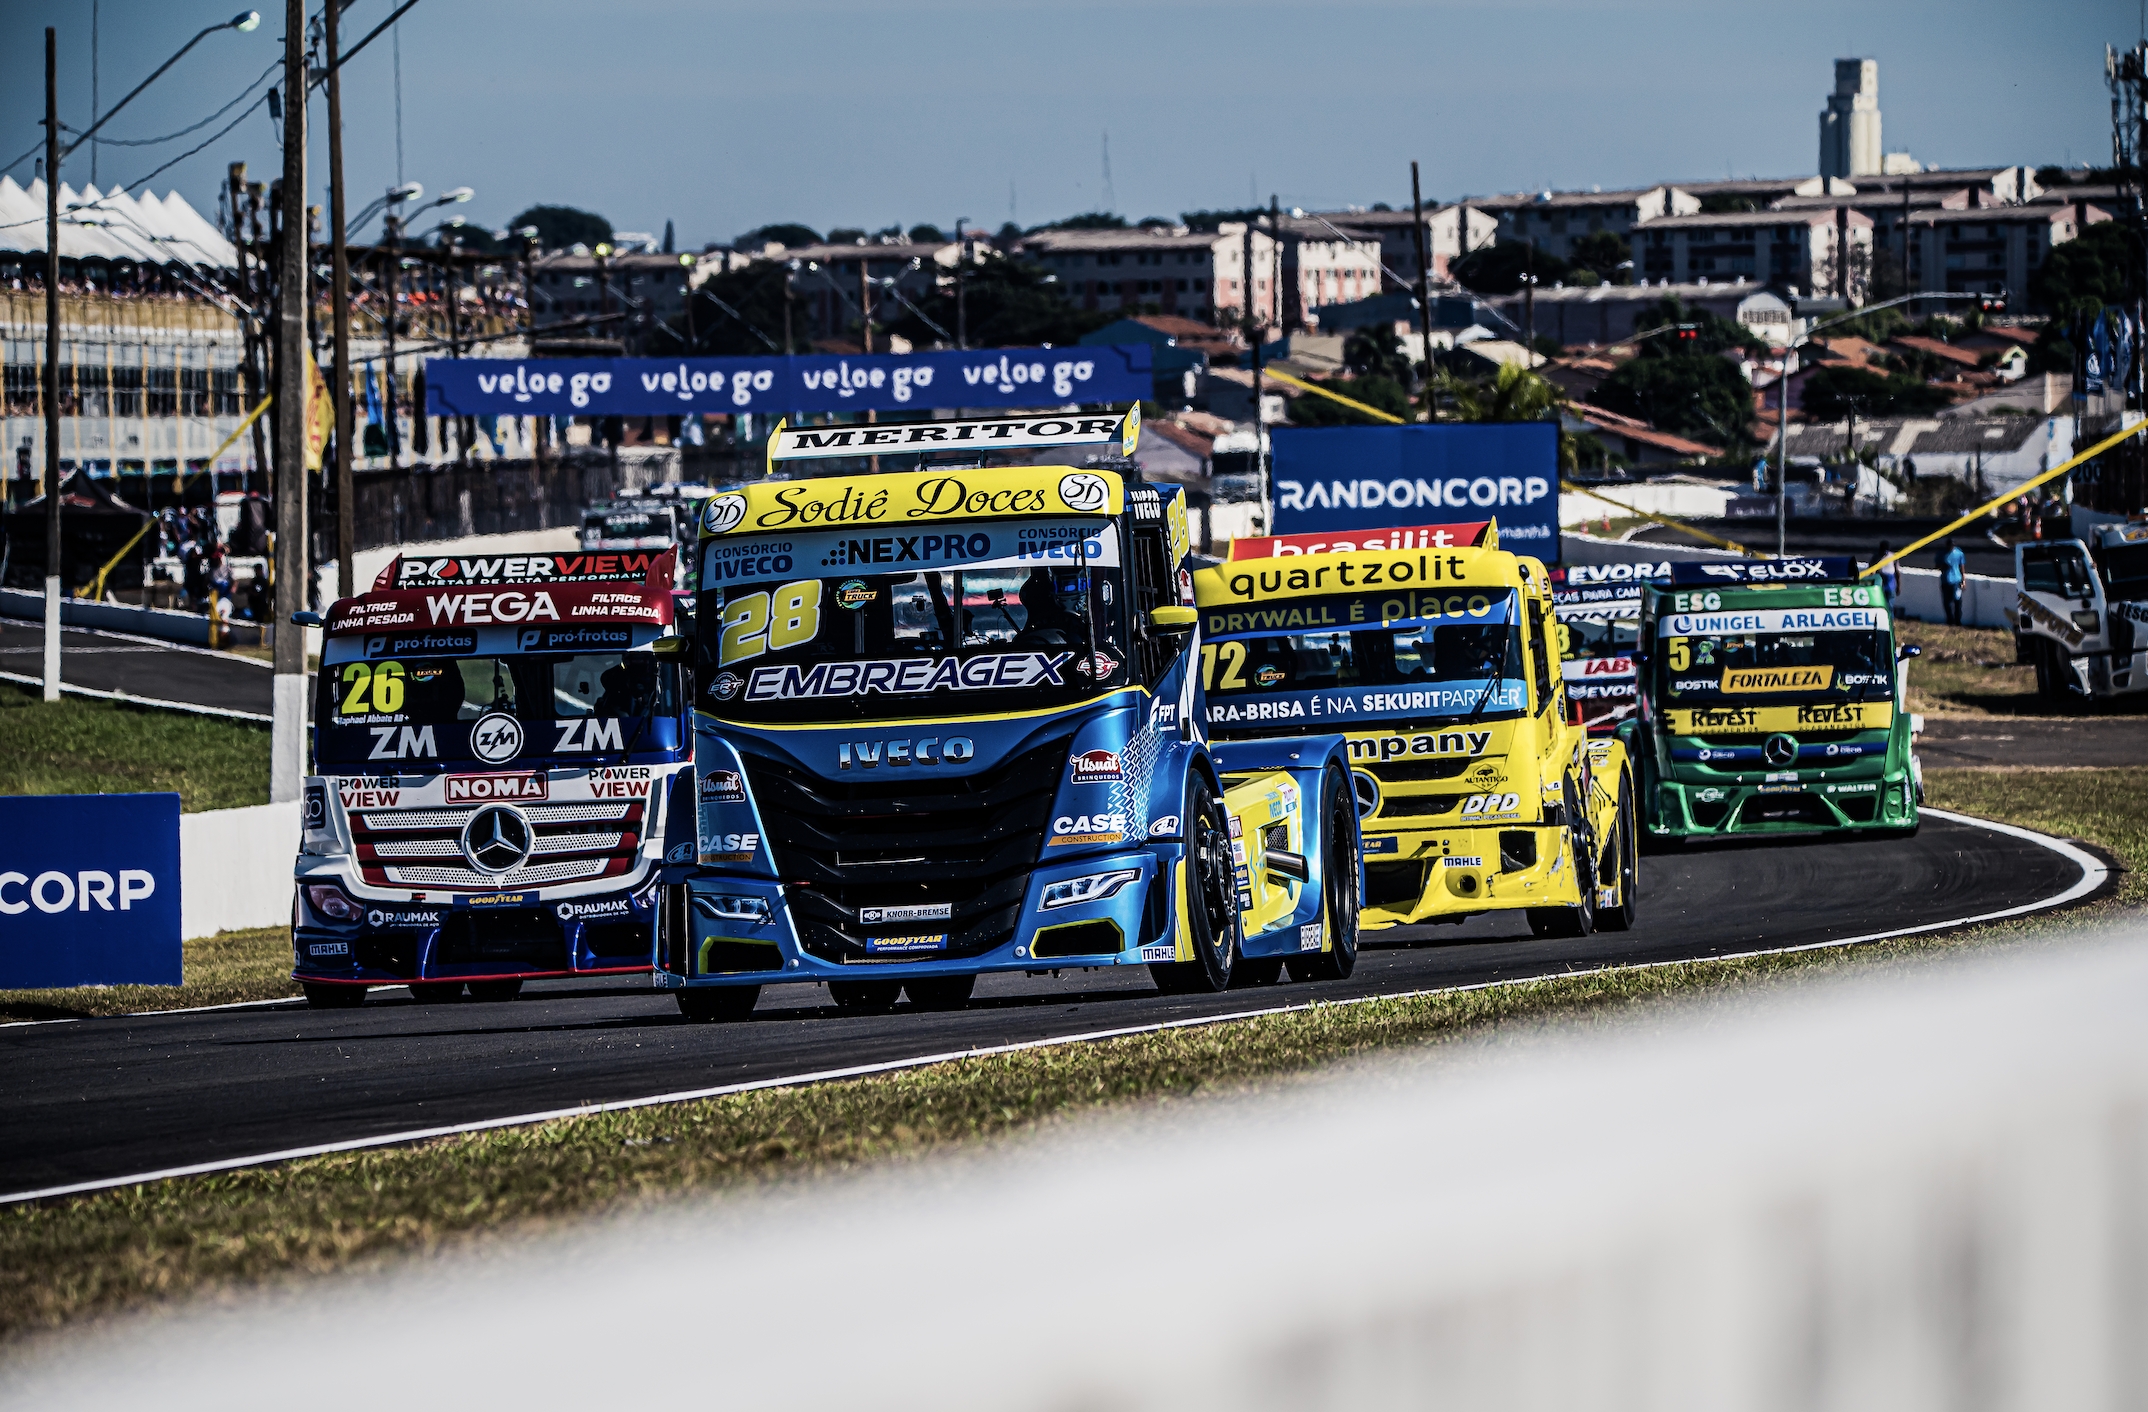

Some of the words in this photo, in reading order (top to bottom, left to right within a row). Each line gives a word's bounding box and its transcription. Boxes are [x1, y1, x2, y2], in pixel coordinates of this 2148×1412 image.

[478, 365, 564, 402] veloe
[571, 371, 612, 408] go
[641, 363, 725, 401] veloe
[732, 370, 774, 406] go
[803, 360, 886, 398] veloe
[893, 366, 935, 402] go
[963, 355, 1046, 394] veloe
[1053, 361, 1095, 398] go
[792, 419, 1117, 449] MERITOR
[757, 486, 889, 528] Sodiê
[907, 475, 1046, 518] Doces
[1278, 476, 1549, 510] RANDONCORP
[1018, 525, 1101, 539] CONSÓRCIO
[715, 542, 792, 560] CONSÓRCIO
[848, 533, 991, 565] NEXPRO
[1018, 540, 1102, 560] IVECO
[505, 576, 542, 584] ALTA
[549, 572, 646, 582] PERFORMAN
[714, 555, 793, 581] IVECO
[1230, 555, 1466, 600] quartzolit
[1568, 561, 1673, 584] EVORA
[591, 593, 642, 604] FILTROS
[1675, 592, 1722, 613] ESG
[1823, 587, 1870, 607] ESG
[349, 602, 398, 615] FILTROS
[426, 591, 561, 625] WEGA
[572, 605, 609, 616] LINHA
[611, 605, 660, 618] PESADA
[1209, 606, 1336, 634] DRYWALL
[1350, 600, 1366, 622] É
[1382, 591, 1491, 628] placo
[331, 617, 364, 631] LINHA
[366, 612, 415, 626] PESADA
[718, 578, 823, 669] 28
[1695, 615, 1765, 632] UNIGEL
[1781, 612, 1875, 629] ARLAGEL
[1669, 636, 1690, 672] 5
[745, 652, 1075, 701] EMBREAGEX
[1676, 680, 1719, 690] BOSTIK
[1730, 670, 1823, 688] FORTALEZA
[341, 661, 405, 714] 26
[1159, 704, 1176, 722] FPT
[1311, 695, 1321, 716] É
[1327, 696, 1357, 715] NA
[368, 725, 438, 760] ZM
[553, 718, 624, 753] ZM
[838, 735, 975, 770] IVECO
[588, 767, 650, 780] POWER
[1077, 773, 1120, 782] BRINQUEDOS
[339, 778, 400, 790] POWER
[450, 777, 544, 798] NOMA
[590, 781, 651, 798] VIEW
[339, 791, 400, 808] VIEW
[1462, 793, 1520, 814] DPD
[1053, 814, 1127, 834] CASE
[699, 833, 760, 852] CASE
[1061, 834, 1121, 843] CONSTRUCTION
[1444, 857, 1482, 866] MAHLE
[469, 894, 523, 905] GOODYEAR
[575, 900, 629, 915] RAUMAK
[386, 911, 439, 922] RAUMAK
[886, 907, 949, 918] KNORR-BREMSE
[311, 943, 347, 954] MAHLE
[873, 934, 943, 946] GOODYEAR
[1142, 947, 1174, 960] MAHLE
